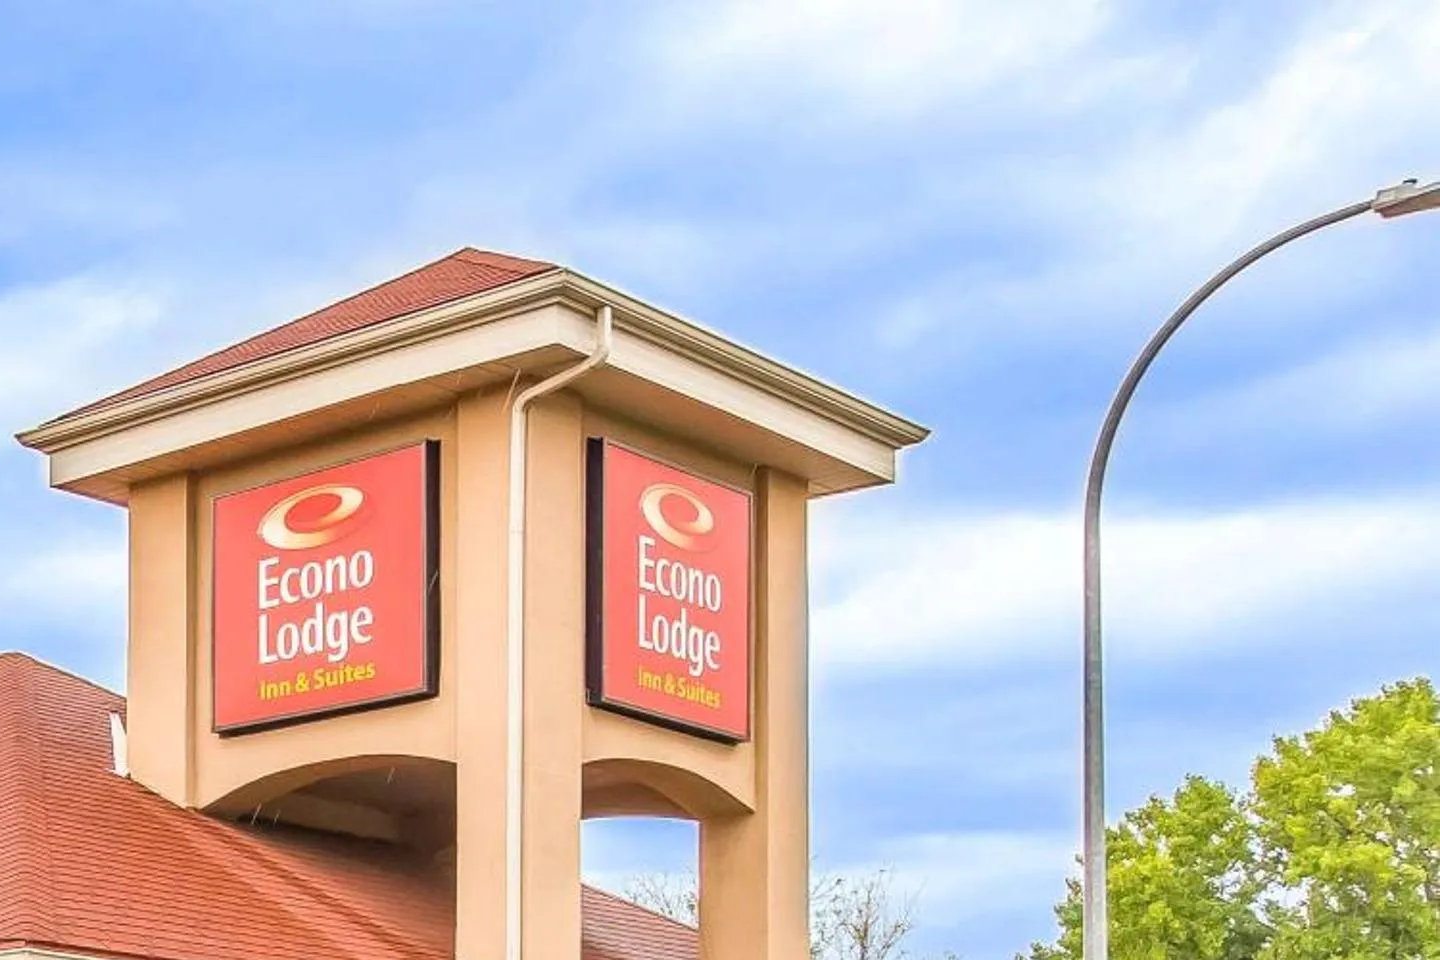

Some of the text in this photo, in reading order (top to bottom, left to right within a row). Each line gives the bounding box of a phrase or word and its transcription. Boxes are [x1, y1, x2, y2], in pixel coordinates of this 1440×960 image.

[258, 550, 374, 610] Econo
[638, 534, 722, 612] Econo
[258, 602, 374, 664] Lodge
[637, 594, 721, 677] Lodge
[260, 662, 375, 700] Inn & Suites
[638, 666, 721, 709] Inn & Suites
